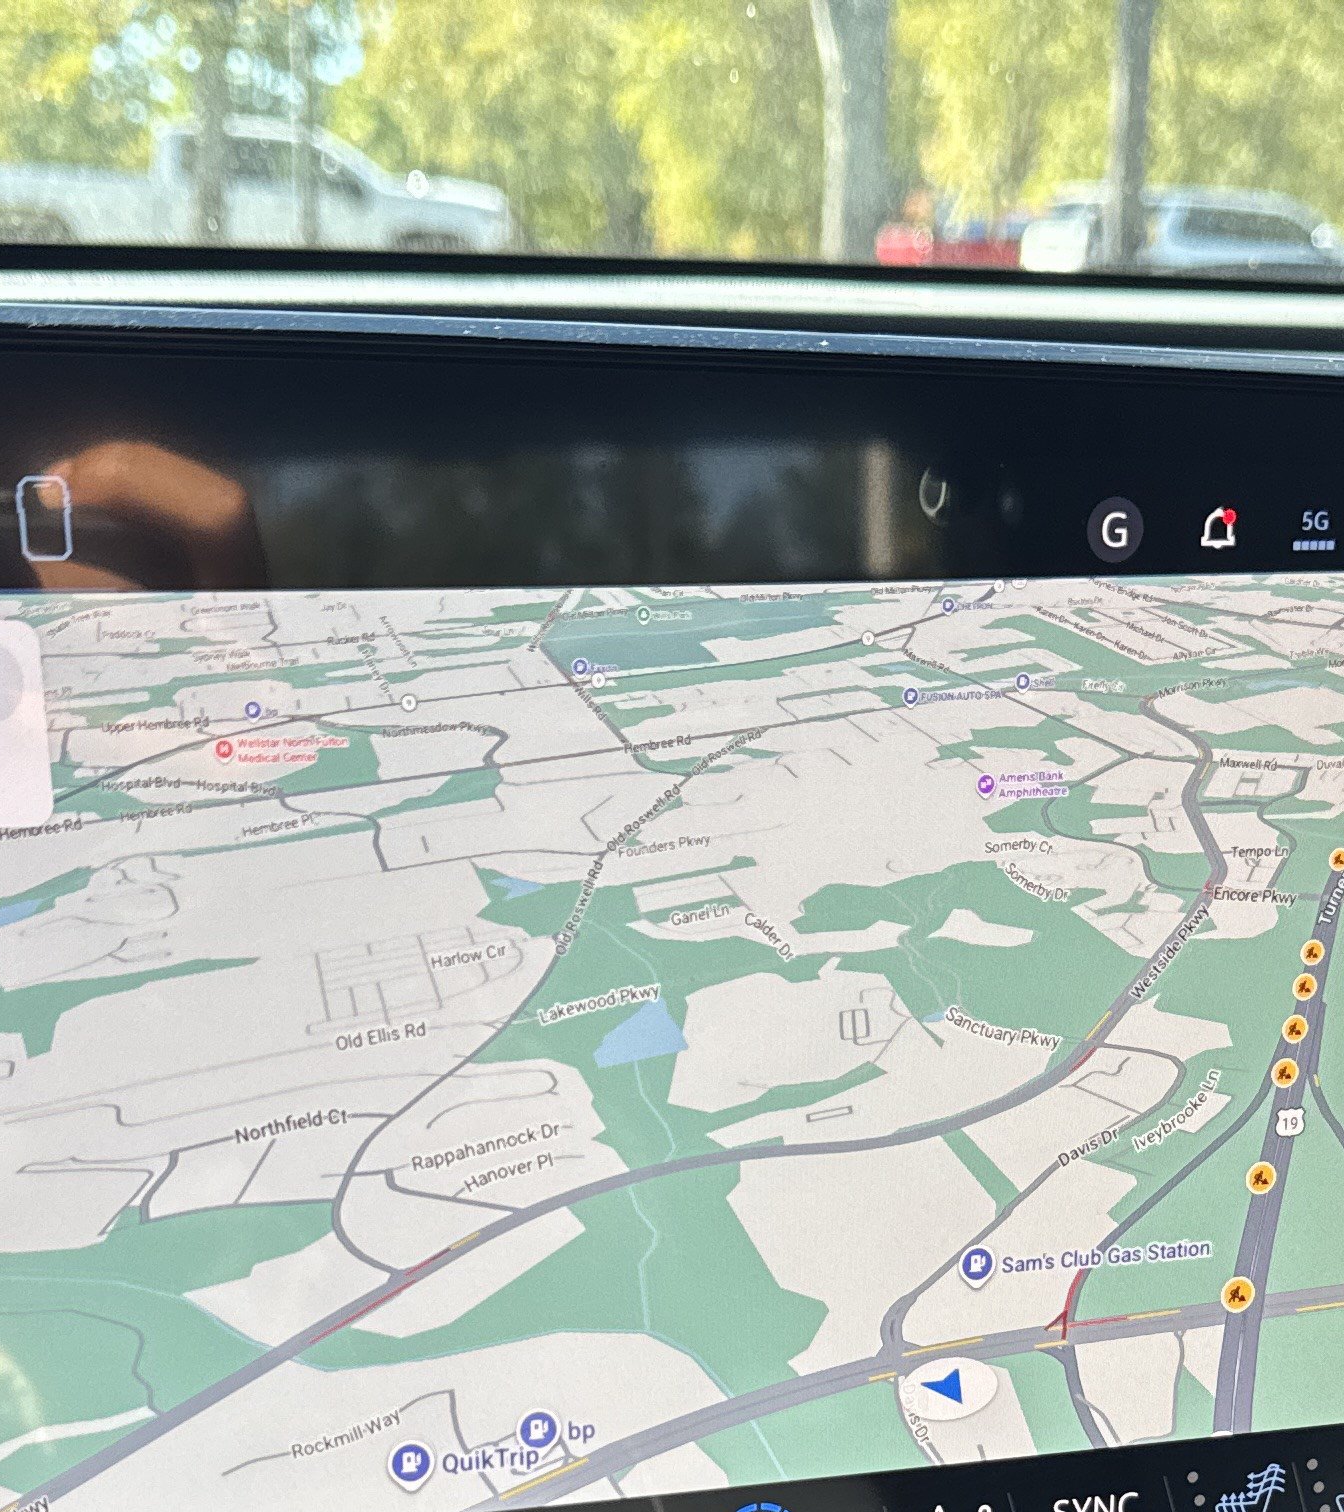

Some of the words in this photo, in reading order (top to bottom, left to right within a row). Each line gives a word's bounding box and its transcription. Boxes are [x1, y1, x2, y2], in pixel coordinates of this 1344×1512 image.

[1102, 511, 1128, 548] G
[1302, 510, 1329, 531] 5G
[1036, 606, 1059, 619] Karen
[1074, 622, 1097, 637] Karen
[1155, 635, 1165, 643] Dr
[1114, 640, 1136, 655] Karen
[1032, 678, 1055, 687] Shell
[921, 692, 957, 701] FUSION
[957, 691, 983, 700] AUTO
[194, 716, 210, 727] Rd
[593, 707, 606, 720] Rd
[237, 738, 280, 748] Wellstar
[624, 736, 674, 754] Hembree
[676, 734, 692, 747] Rd
[692, 757, 711, 777] Old
[706, 733, 749, 767] Roswell
[743, 727, 762, 743] Rd
[238, 753, 280, 763] Medical
[283, 753, 318, 763] Center
[1219, 756, 1261, 771] Maxwell
[1263, 758, 1278, 771] Rd
[176, 804, 193, 814] Rd
[606, 827, 631, 852] Old
[625, 796, 669, 834] Roswell
[663, 784, 682, 803] Rd
[0, 824, 60, 841] Hembree
[62, 818, 83, 832] Rd
[242, 816, 299, 837] Hembree
[617, 840, 676, 858] Founders
[679, 834, 711, 850] Pkwy
[1231, 846, 1272, 858] Tempo
[1274, 846, 1289, 857] Ln
[1005, 862, 1052, 900] Somerby
[1054, 888, 1068, 900] Dr
[555, 932, 572, 957] Old
[566, 876, 596, 935] Roswell
[587, 859, 603, 880] Rd
[1213, 887, 1260, 902] Encore
[1261, 889, 1297, 906] Pkwy
[714, 904, 730, 918] Ln
[744, 912, 783, 948] Calder
[777, 940, 796, 961] Dr
[431, 950, 482, 969] Harlow
[1130, 938, 1183, 1000] Westside
[1177, 903, 1210, 943] Pkwy
[539, 993, 616, 1023] Lakewood
[620, 985, 660, 1005] Pkwy
[335, 1035, 363, 1052] Old
[367, 1027, 400, 1047] Ellis
[404, 1022, 426, 1039] Rd
[945, 1006, 1019, 1046] Sanctuary
[1020, 1028, 1061, 1051] Pkwy
[1132, 1091, 1209, 1153] Iveybrooke
[1202, 1068, 1221, 1094] Ln
[234, 1110, 323, 1144] Northfield
[328, 1109, 348, 1125] Ct
[1282, 1116, 1298, 1131] 19
[411, 1128, 538, 1172] Rappahannock
[540, 1123, 560, 1139] Dr
[1057, 1138, 1099, 1168] Davis
[1100, 1127, 1120, 1147] Dr
[464, 1159, 533, 1193] Hanover
[537, 1154, 554, 1170] Pl
[1001, 1253, 1055, 1274] Sam's
[1060, 1249, 1102, 1269] Club
[1107, 1246, 1142, 1265] Gas
[1148, 1241, 1210, 1260] Station
[291, 1426, 364, 1459] Rockmill
[365, 1410, 401, 1434] Way
[568, 1420, 596, 1444] bp
[442, 1445, 539, 1475] QuikTrip
